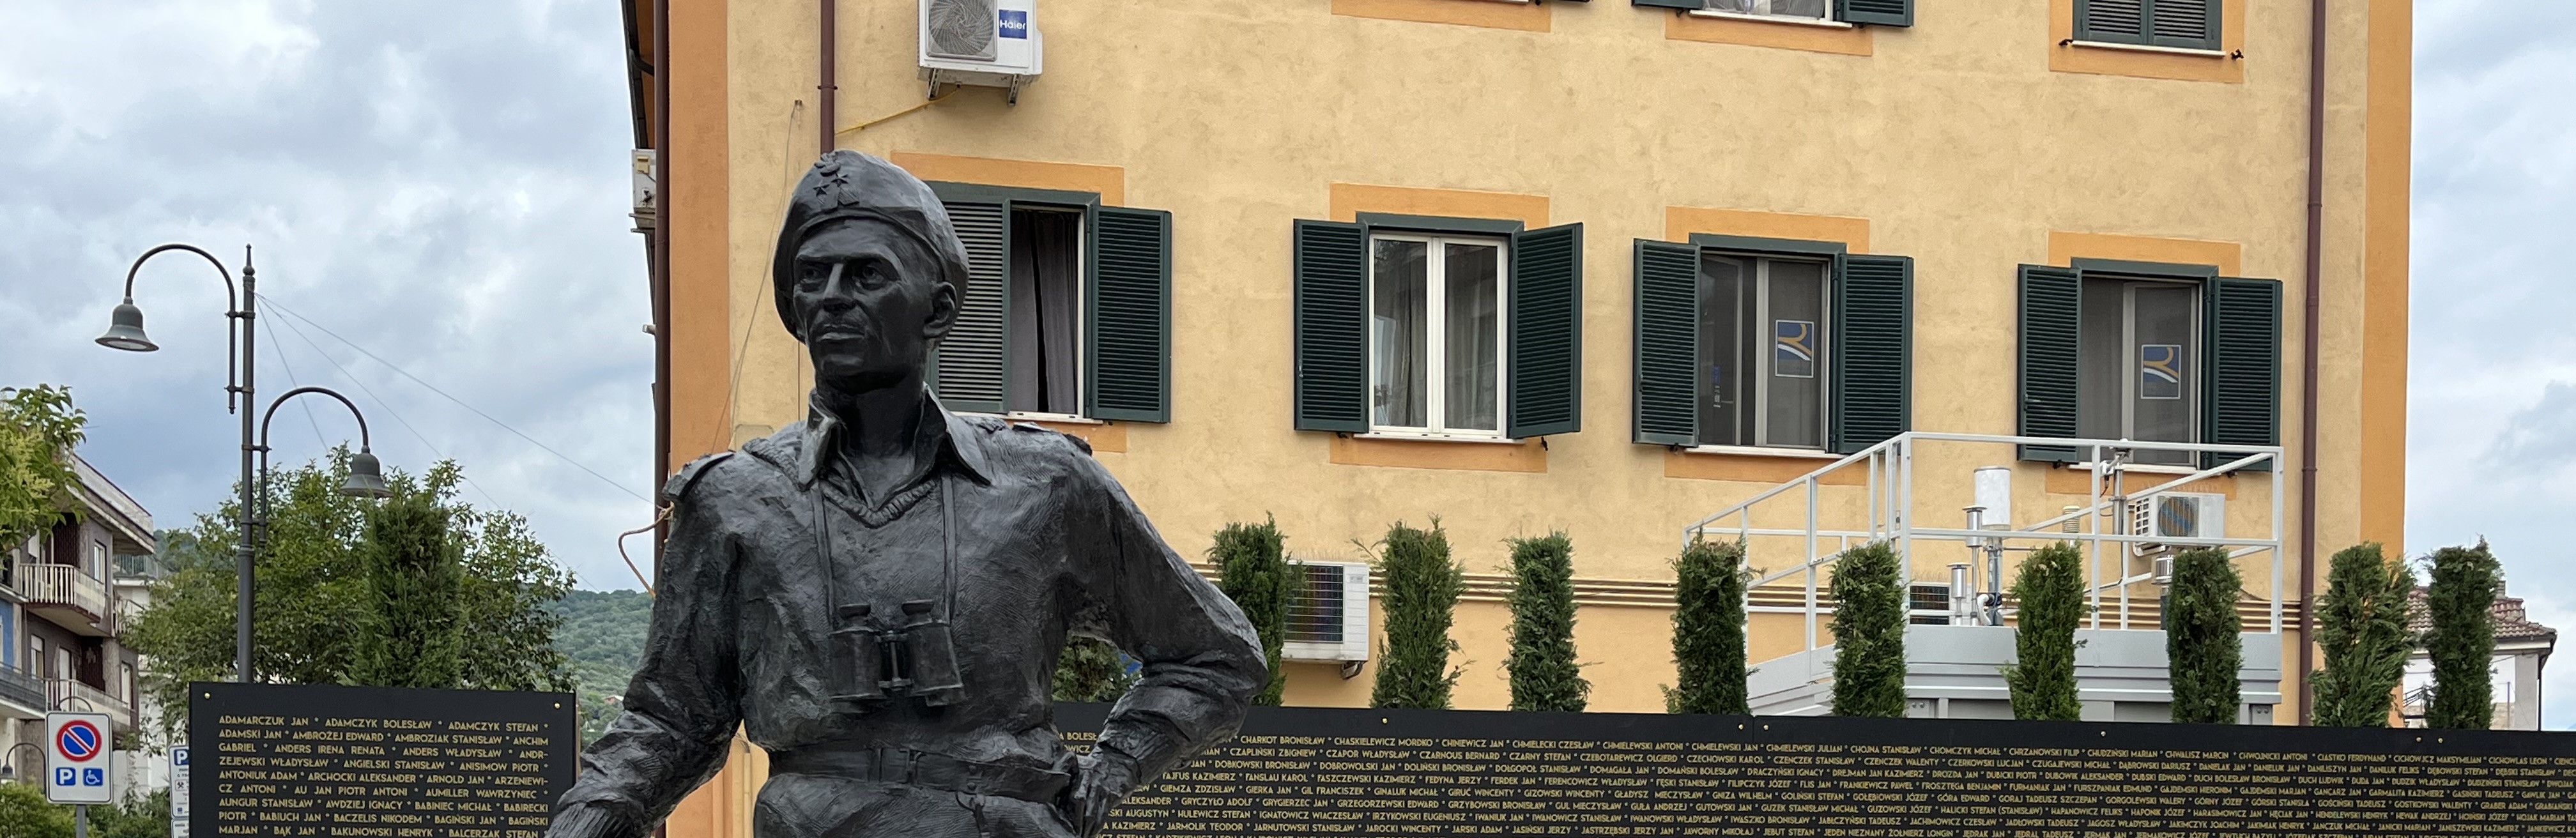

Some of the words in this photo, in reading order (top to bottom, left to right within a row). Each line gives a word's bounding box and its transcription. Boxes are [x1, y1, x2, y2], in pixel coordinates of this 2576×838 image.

[999, 19, 1026, 30] Haier
[219, 715, 284, 725] ADAMARCZUK
[291, 717, 309, 726] JAN
[325, 717, 377, 728] ADAMCZYK
[383, 719, 432, 729] BOLESŁAW
[448, 721, 500, 731] ADAMCZYK
[506, 722, 538, 731] STEFAN
[219, 729, 260, 738] ADAMSKI
[264, 729, 281, 738] JAN
[293, 730, 342, 740] AMBROŻEJ
[346, 732, 383, 741] EDWARD
[395, 733, 448, 743] AMBROZIAK
[452, 735, 502, 744] STANISŁAW
[513, 736, 548, 745] ANCHIM
[1067, 732, 1098, 742] BOLESŁ
[1241, 735, 1277, 743] CHARKOT
[1280, 736, 1325, 745] BRONISŁAW
[1334, 736, 1395, 746] CHASKIELEWICZ
[1399, 738, 1433, 747] MORDKO
[219, 742, 256, 752] GABRIEL
[275, 744, 311, 753] ANDERS
[318, 745, 344, 754] IRENA
[351, 745, 385, 756] RENATA
[403, 747, 438, 756] ANDERS
[445, 747, 502, 757] WŁADYSŁAW
[1230, 747, 1275, 756] CZAPLIŃSKI
[1278, 748, 1316, 757] ZBIGNIEW
[1326, 749, 1359, 758] CZAPOR
[1362, 750, 1409, 759] WŁADYSŁAW
[1420, 750, 1462, 759] CZARNOUS
[1466, 751, 1499, 759] BERNARD
[177, 750, 188, 765] P
[219, 756, 265, 766] ZEJEWSKI
[270, 758, 328, 767] WŁADYSŁAW
[344, 759, 390, 768] ANGIELSKI
[395, 760, 445, 770] STANISŁAW
[459, 761, 508, 771] ANISIMOW
[512, 763, 539, 772] PIOTR
[1191, 759, 1206, 768] JAN
[1215, 759, 1262, 769] DOBKOWSKI
[1265, 761, 1310, 769] BRONISŁAW
[1320, 761, 1377, 770] DOBROWOLSKI
[1381, 762, 1395, 770] JAN
[1404, 762, 1439, 771] DOLIŃSKI
[1442, 763, 1486, 772] BRONISŁAW
[59, 768, 73, 784] P
[219, 770, 266, 779] ANTONIUK
[270, 771, 297, 781] ADAM
[308, 772, 356, 781] ARCHOCKI
[359, 773, 416, 782] ALEKSANDER
[427, 774, 464, 783] ARNOLD
[468, 775, 484, 784] JAN
[1163, 772, 1190, 780] FAJFUS
[1193, 772, 1236, 781] KAZIMIERZ
[1246, 772, 1279, 781] FANSLAU
[1282, 773, 1308, 782] KAROL
[1317, 774, 1371, 782] FASZCZEWSKI
[1374, 775, 1416, 783] KAZIMIERZ
[1425, 775, 1454, 784] FEDYNA
[219, 784, 233, 793] CZ
[240, 784, 275, 793] ANTONI
[295, 785, 307, 794] AU
[314, 786, 332, 795] JAN
[339, 786, 365, 795] PIOTR
[373, 787, 407, 796] ANTONI
[425, 788, 469, 797] AUMILLER
[476, 789, 537, 798] WAWRZYNIEC
[1160, 784, 1191, 793] GIEMZA
[1195, 784, 1236, 793] ZDZISŁAW
[1246, 785, 1273, 794] GIERKA
[1277, 786, 1291, 794] JAN
[1317, 786, 1364, 795] FRANCISZEK
[1409, 788, 1438, 796] MICHAŁ
[1448, 787, 1471, 796] GIRUĆ
[219, 797, 257, 807] AUNGUR
[262, 798, 312, 807] STANISŁAW
[326, 800, 365, 809] AWDZIEJ
[369, 800, 402, 809] IGNACY
[415, 801, 454, 811] BABINIEC
[458, 802, 492, 811] MICHAŁ
[504, 803, 548, 812] BABIRECKI
[1123, 796, 1172, 805] ALEKSANDER
[1181, 797, 1224, 805] GRYCZYŁO
[1227, 798, 1253, 806] ADOLF
[1262, 798, 1312, 807] GRYGIERZEC
[1314, 798, 1328, 807] JAN
[1337, 798, 1405, 808] GRZEGORZEWSKI
[1407, 800, 1439, 808] EDWARD
[1448, 800, 1500, 809] GRZYBOWSKI
[219, 811, 247, 820] PIOTR
[260, 811, 299, 821] BABIUCH
[304, 812, 321, 821] JAN
[334, 813, 377, 822] BACZELIS
[381, 814, 422, 823] NIKODEM
[434, 814, 475, 824] BAGIŃSKI
[479, 815, 496, 825] JAN
[509, 815, 548, 825] BAGIŃSKI
[1126, 809, 1169, 818] AUGUSTYN
[1178, 809, 1219, 818] HULEWICZ
[1222, 810, 1250, 818] STEFAN
[1259, 810, 1309, 819] IGNATOWICZ
[1312, 811, 1363, 819] WIACZESŁAW
[1372, 811, 1421, 820] IRZYKOWSKI
[1423, 812, 1466, 821] EUGENIUSZ
[219, 825, 257, 834] MARJAN
[274, 826, 291, 836] BĄK
[298, 826, 315, 835] JAN
[331, 827, 392, 836] BAKUNOWSKI
[398, 827, 433, 837] HENRYK
[1112, 821, 1156, 830] KAZIMIERZ
[1167, 821, 1206, 830] JARMOLIK
[1209, 822, 1243, 831] TEODOR
[1254, 823, 1309, 832] JARNUTOWSKI
[1312, 823, 1354, 832] STANISŁAW
[1365, 824, 1398, 832] JAROCKI
[1401, 825, 1441, 833] WINCENTY
